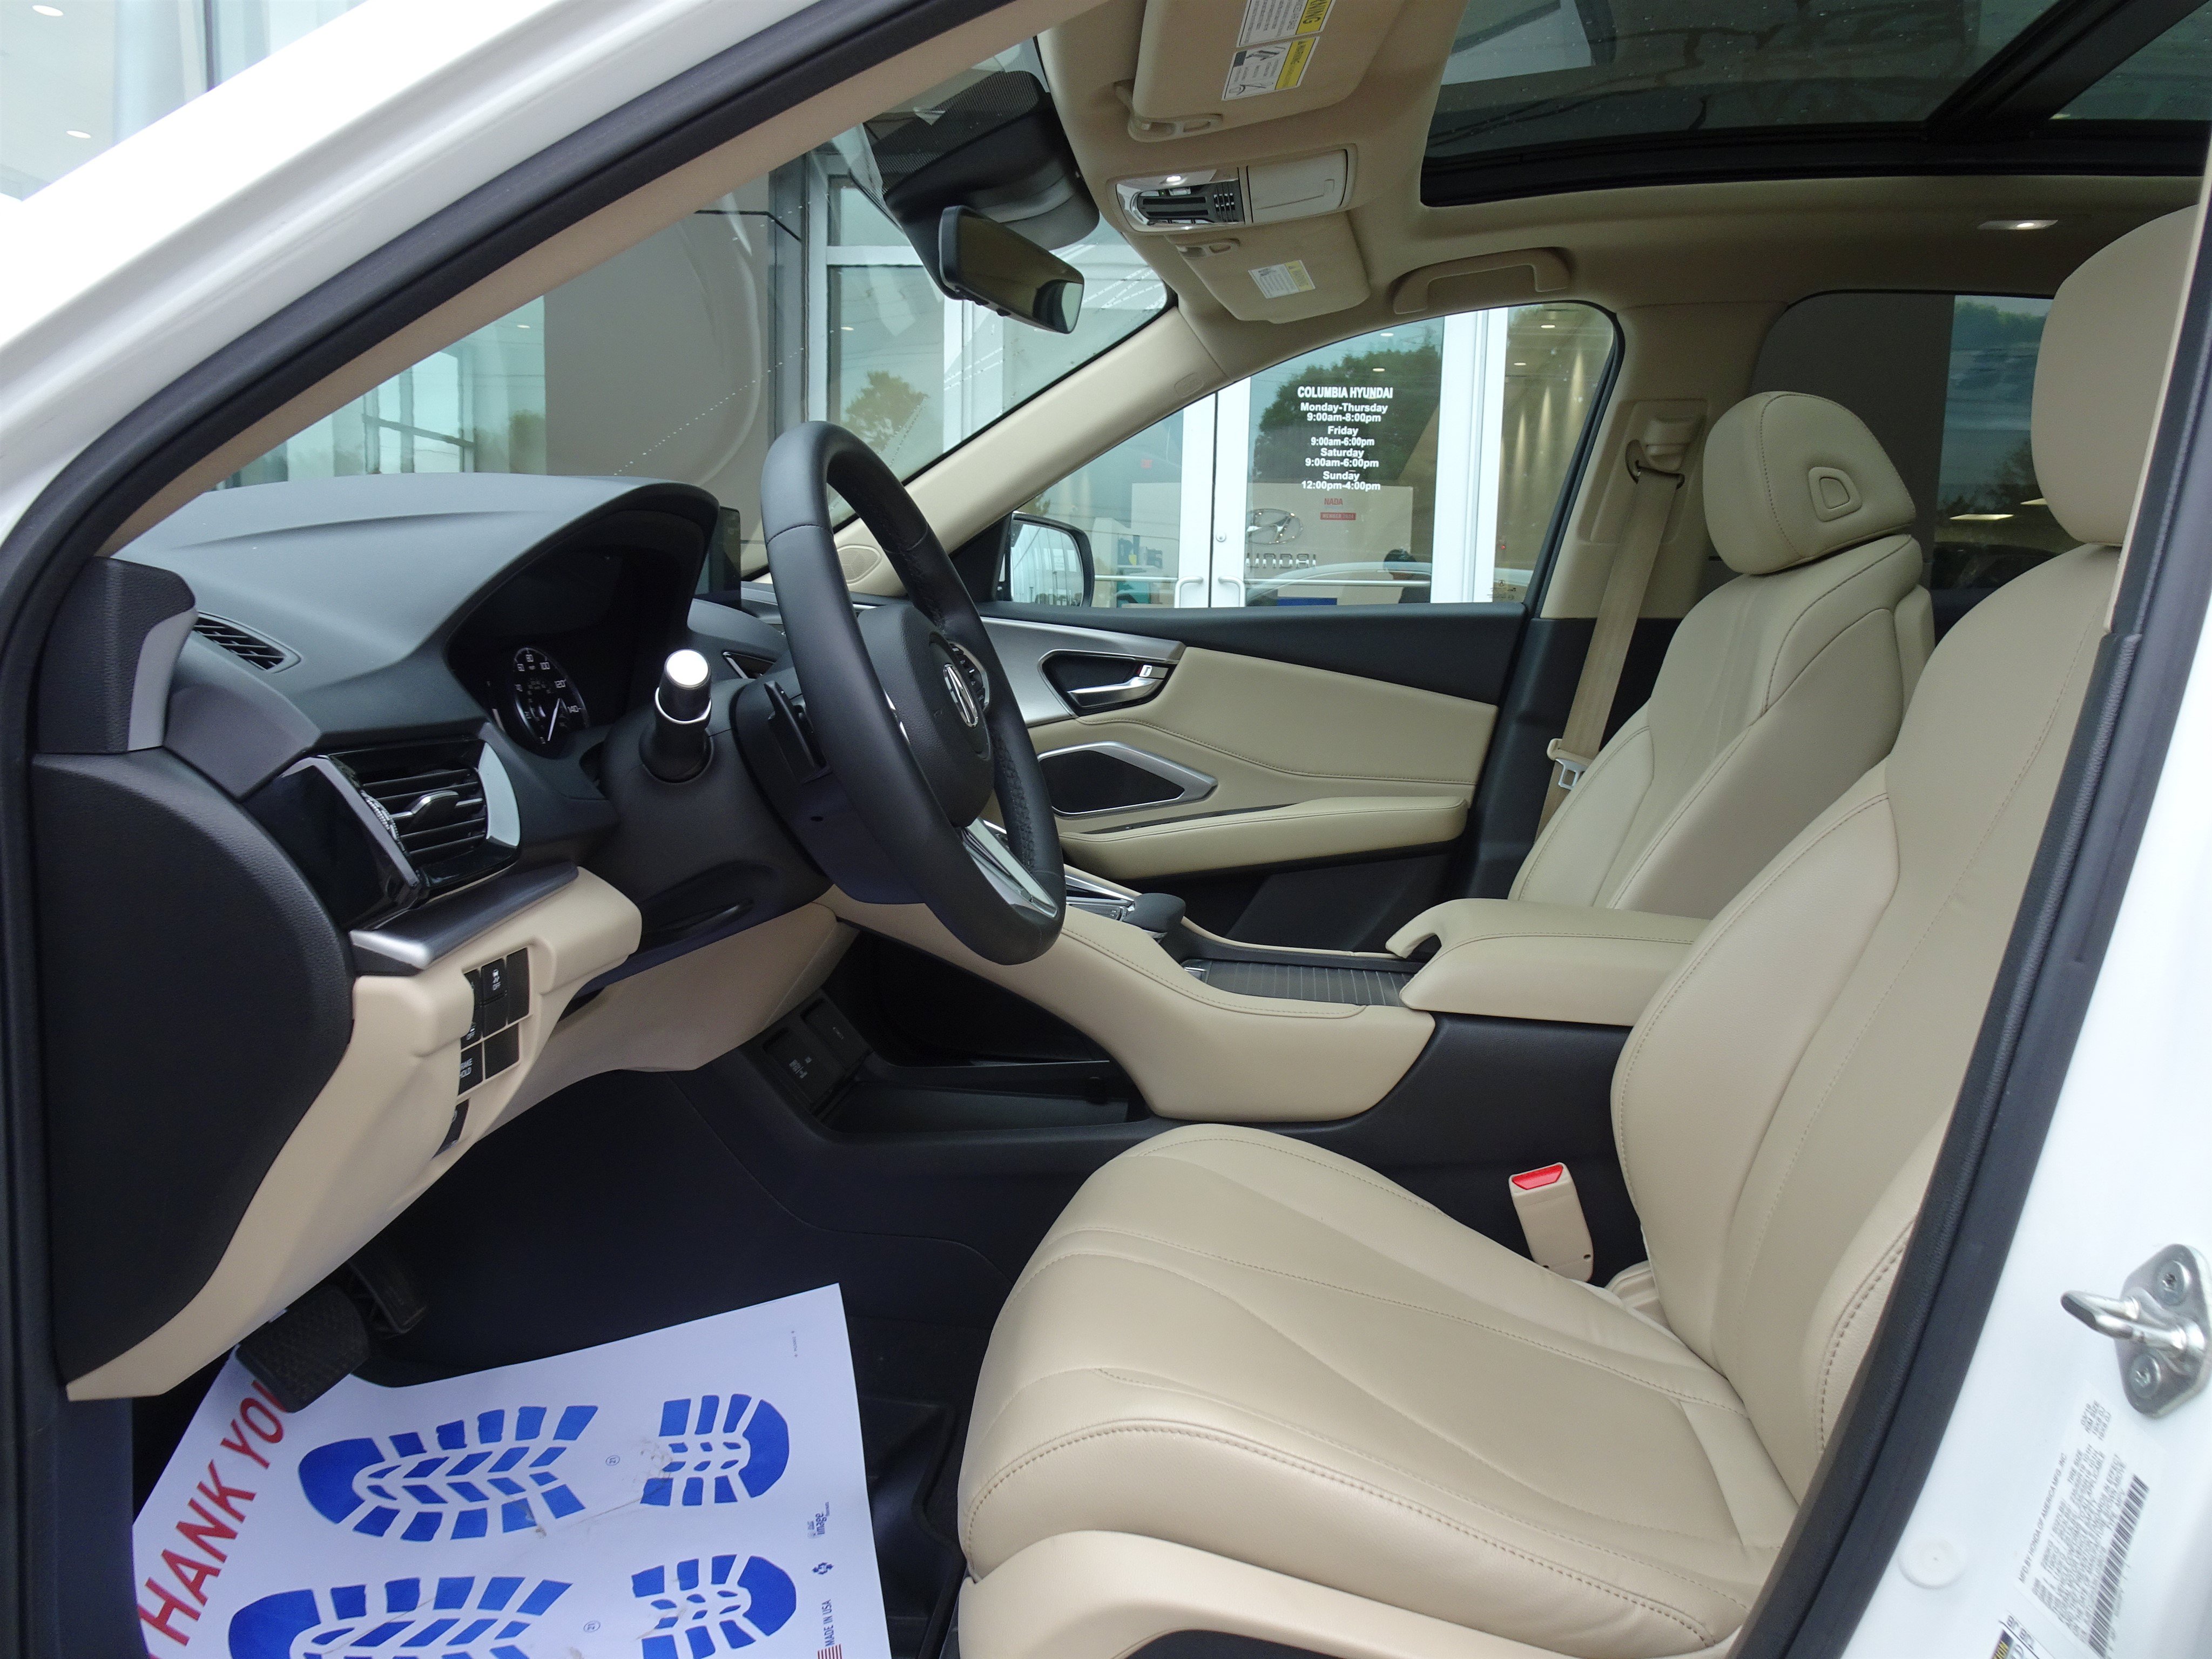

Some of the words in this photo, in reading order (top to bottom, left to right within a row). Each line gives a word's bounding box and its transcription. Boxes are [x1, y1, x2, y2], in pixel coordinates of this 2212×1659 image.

[1303, 0, 1328, 24] NING
[1298, 386, 1347, 399] COLUMBIA
[1350, 387, 1393, 399] HYUNDAI
[1300, 402, 1388, 414] Monday-Thursday
[1307, 412, 1381, 423] 9:00am-8:00pm
[1327, 426, 1359, 437] Friday
[1311, 437, 1374, 447] 9:00am-6:00pm
[1320, 448, 1364, 458] Saturday
[1305, 458, 1379, 468] 9:00am-6:00pm
[1323, 471, 1360, 481] Sunday
[1301, 481, 1381, 491] 12:00pm-4:00pm
[2040, 1483, 2056, 1520] AMERICA
[2036, 1516, 2045, 1531] OF
[2027, 1527, 2041, 1557] HONDA
[138, 1461, 257, 1653] HANK
[2024, 1553, 2032, 1568] BY
[821, 1599, 832, 1615] USA
[823, 1615, 833, 1624] IN
[824, 1624, 834, 1647] MADE
